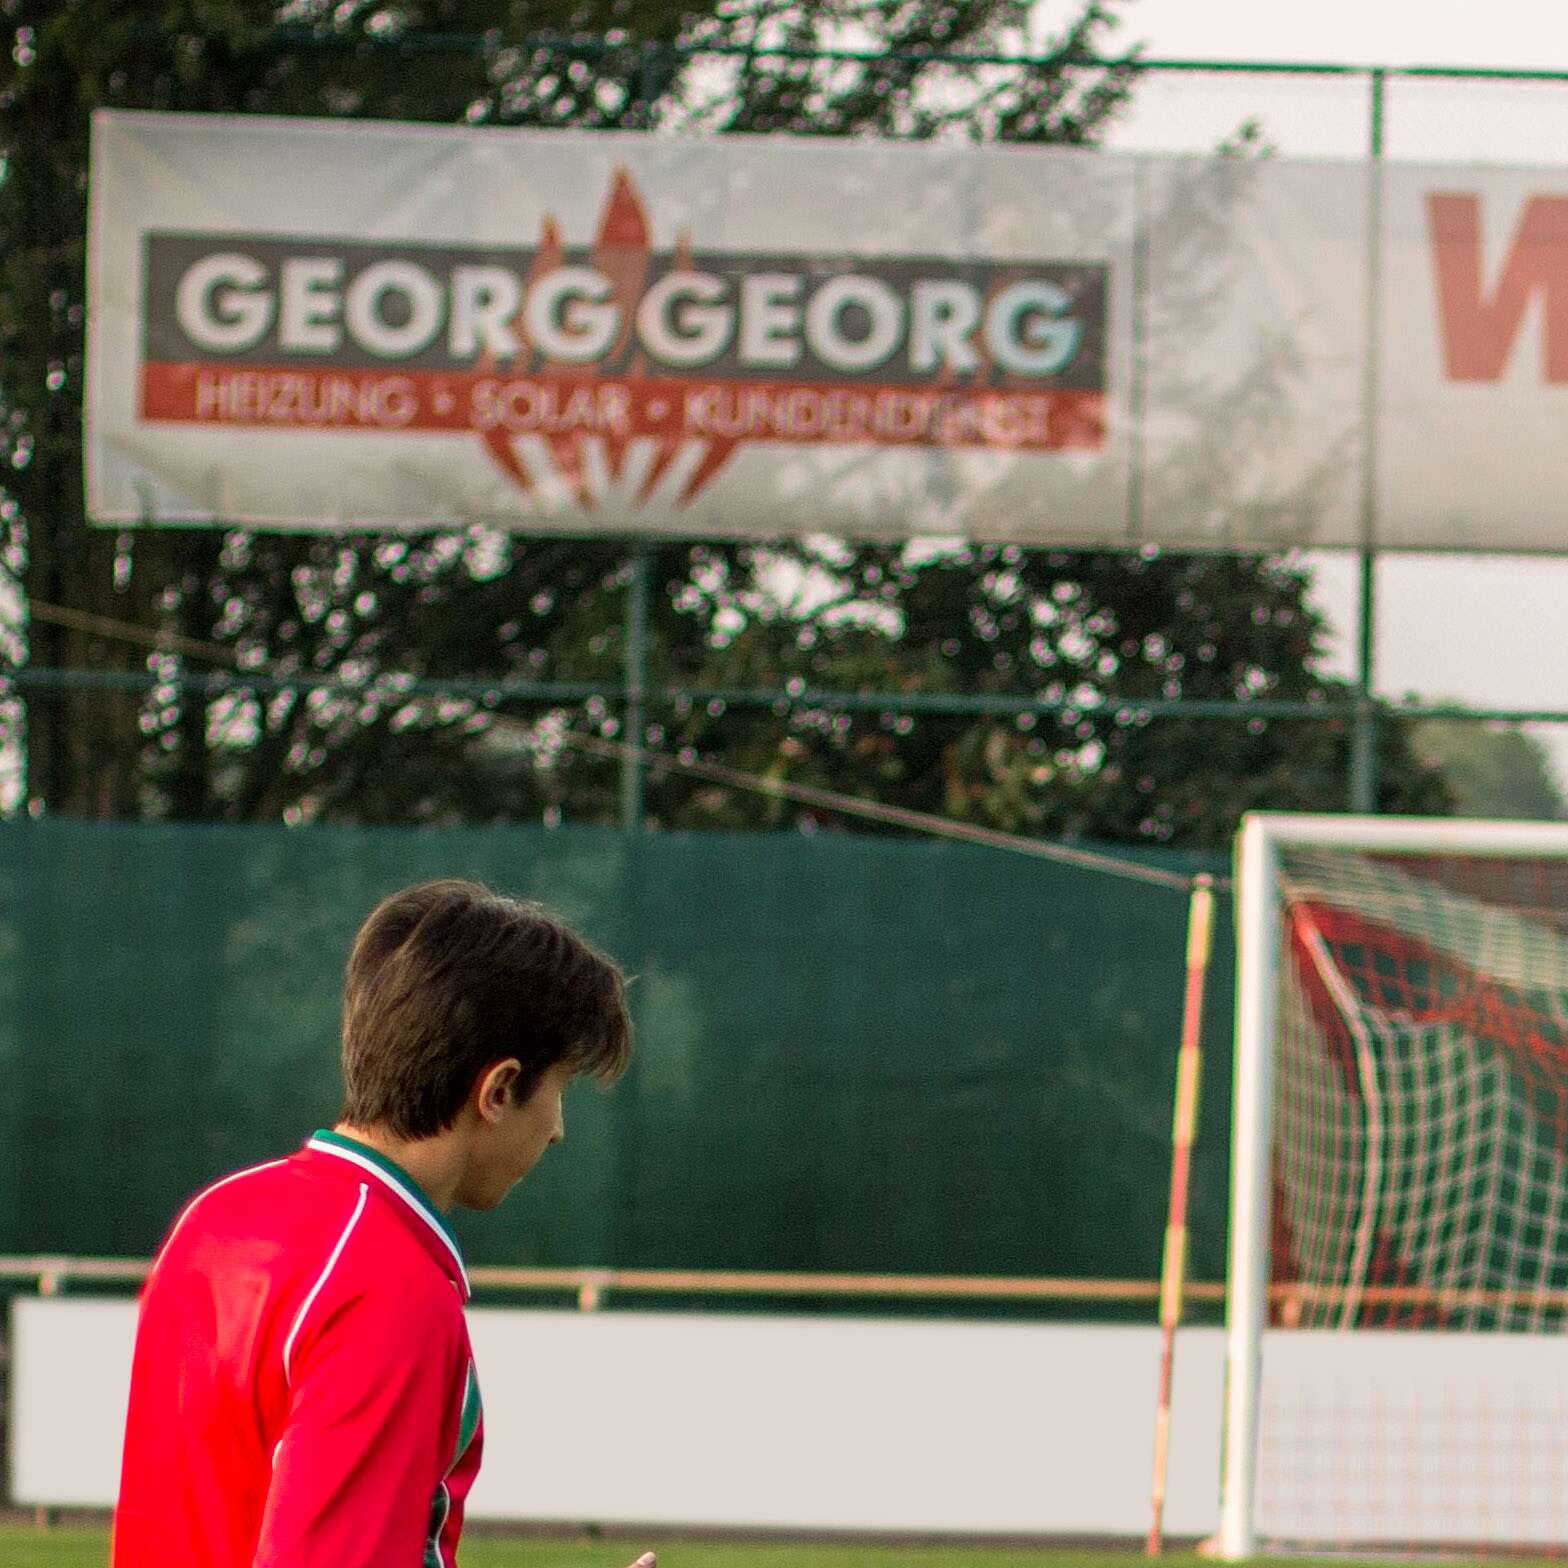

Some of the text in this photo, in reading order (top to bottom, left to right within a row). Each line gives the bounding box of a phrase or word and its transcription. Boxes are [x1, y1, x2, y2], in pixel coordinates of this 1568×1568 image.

[176, 252, 1084, 377] GEORG GEORG
[195, 370, 418, 427] HEIZUNG
[470, 379, 631, 434] SOLAR
